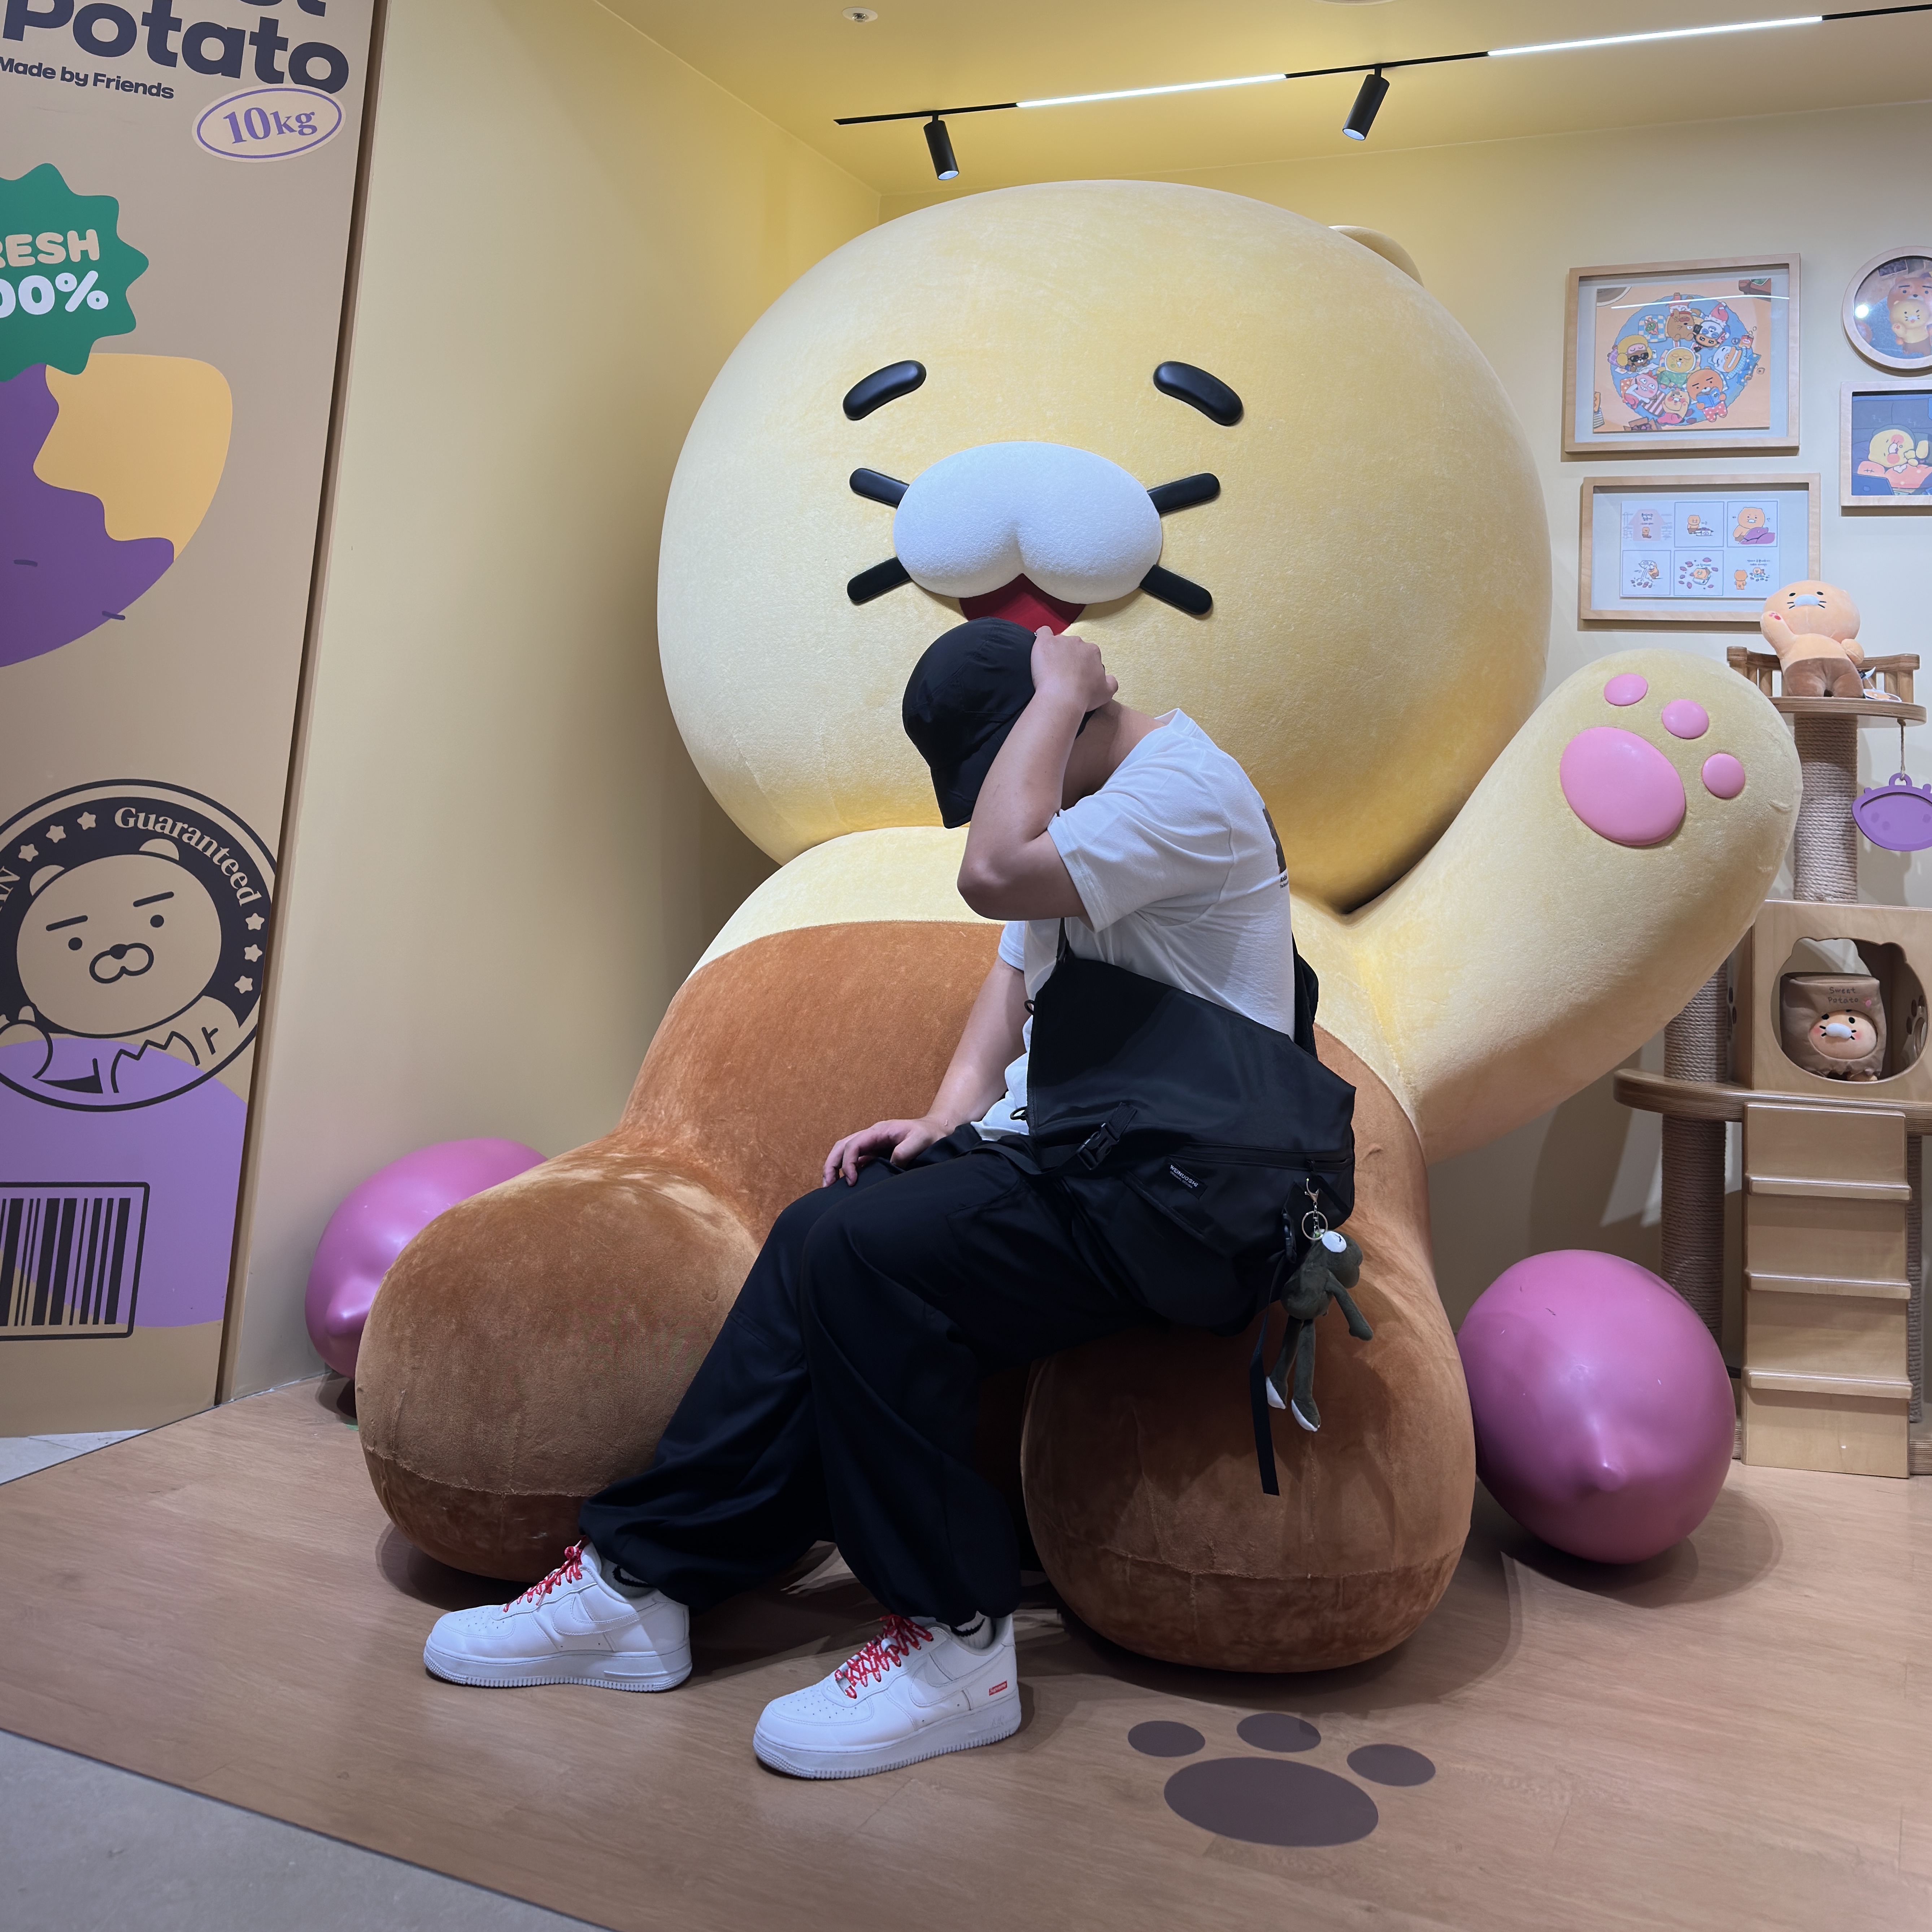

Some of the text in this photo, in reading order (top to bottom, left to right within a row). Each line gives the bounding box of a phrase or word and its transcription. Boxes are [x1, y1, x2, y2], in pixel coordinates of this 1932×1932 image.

[3, 0, 349, 94] Potato
[0, 56, 174, 99] Made by Friends
[223, 107, 318, 144] 10kg
[0, 229, 100, 268] ESH
[114, 807, 262, 907] Guaranteed
[1170, 1165, 1198, 1187] WEINUOSHI
